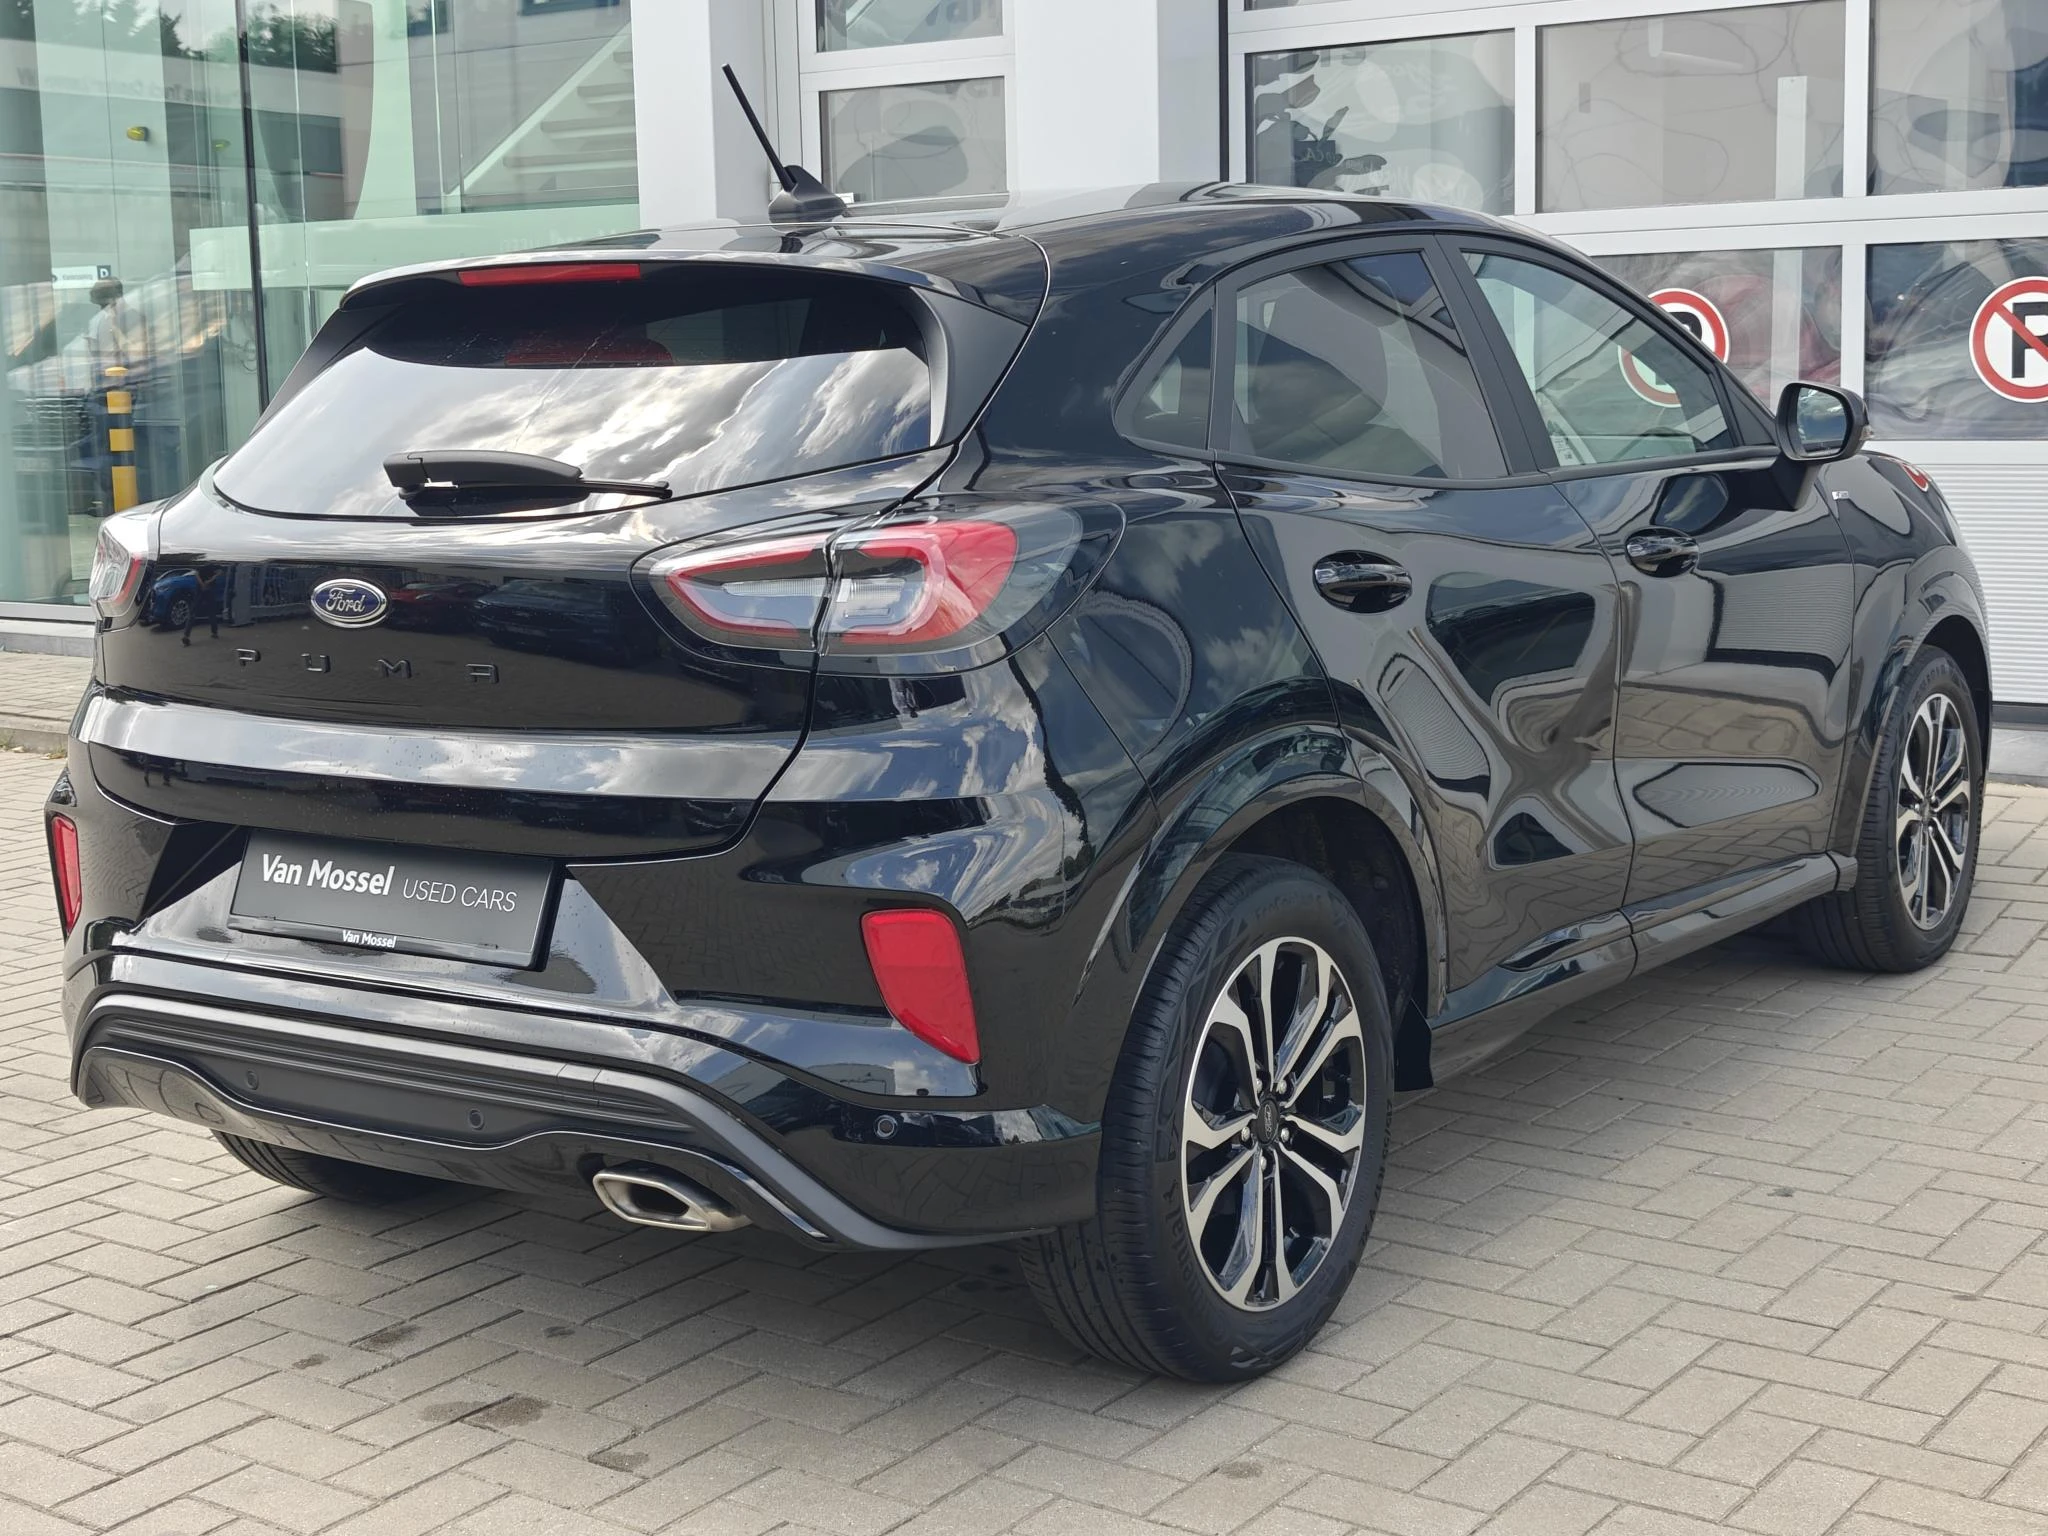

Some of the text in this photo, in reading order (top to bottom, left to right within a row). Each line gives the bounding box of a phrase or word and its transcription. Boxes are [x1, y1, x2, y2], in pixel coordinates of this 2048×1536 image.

[325, 587, 365, 613] Ford
[234, 648, 500, 684] PUMA
[262, 853, 518, 912] Van Mossel USED CARS
[342, 930, 397, 948] Van Mossel
